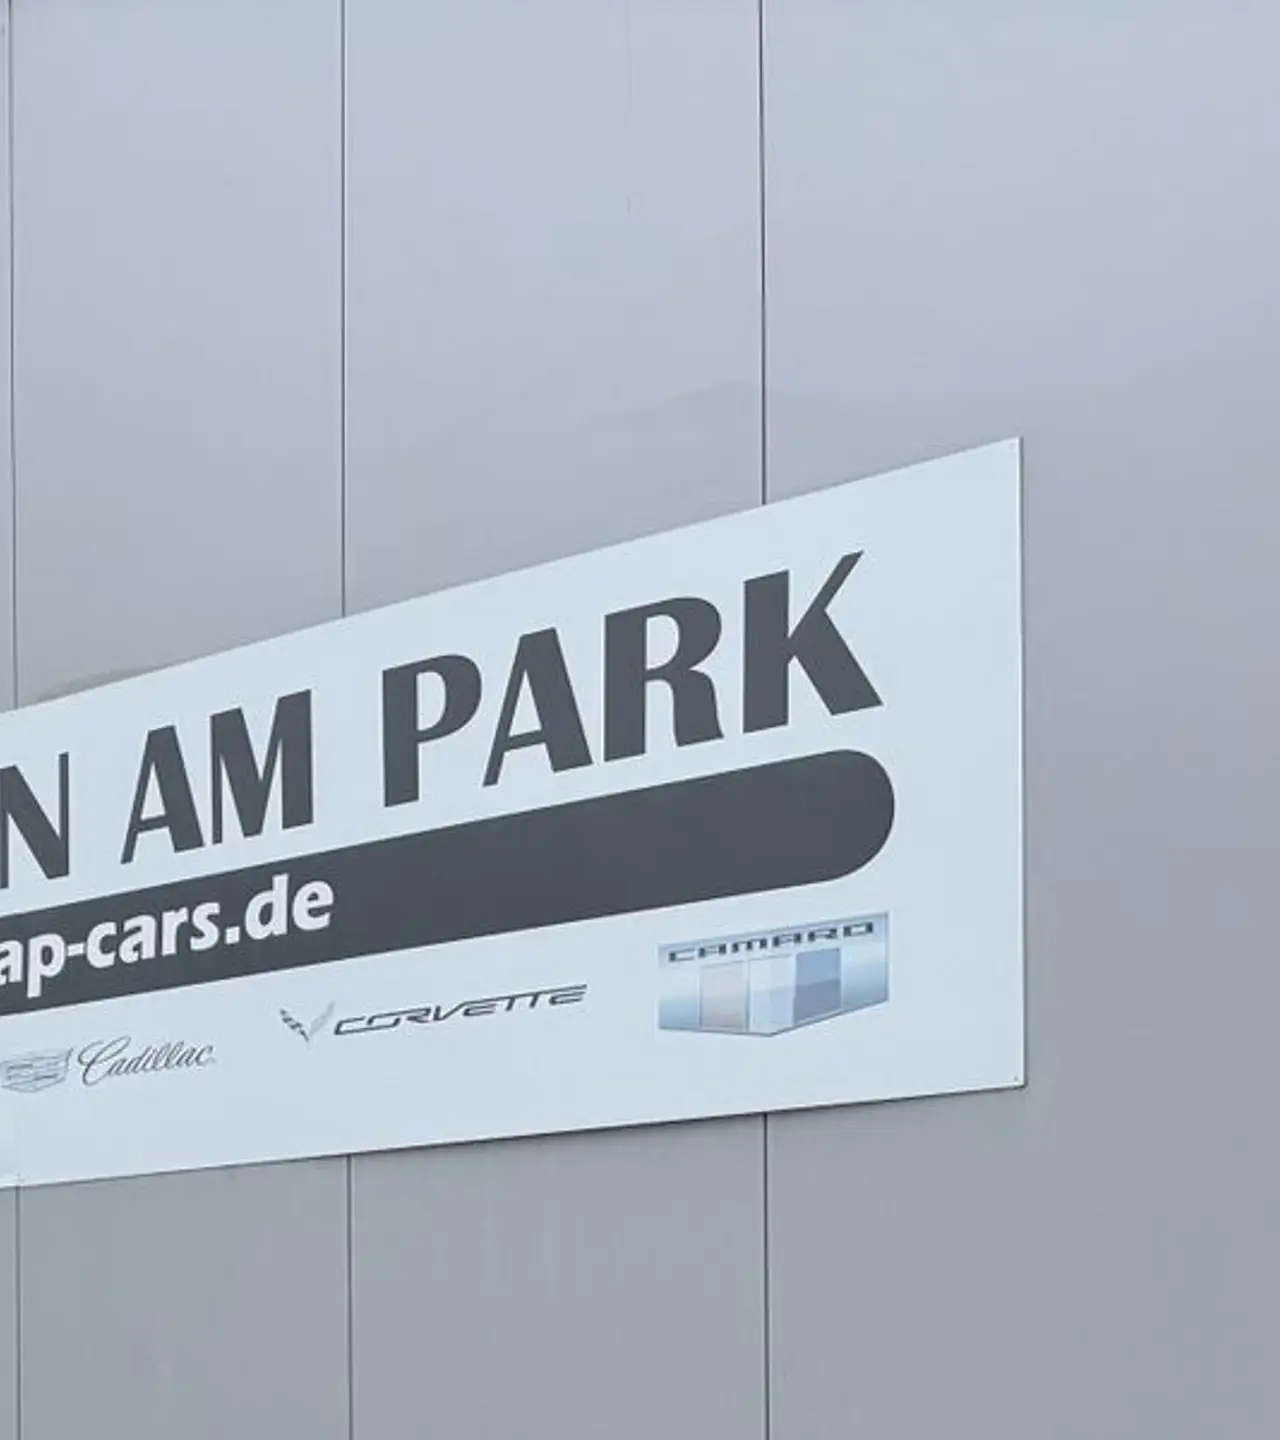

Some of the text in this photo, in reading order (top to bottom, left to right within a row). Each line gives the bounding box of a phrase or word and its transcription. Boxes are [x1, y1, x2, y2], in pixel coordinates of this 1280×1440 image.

[121, 690, 314, 865] AM
[382, 551, 883, 808] PARK
[668, 921, 874, 963] CAMARO
[333, 983, 588, 1036] CORVETTE
[77, 1034, 217, 1087] Cadillac
